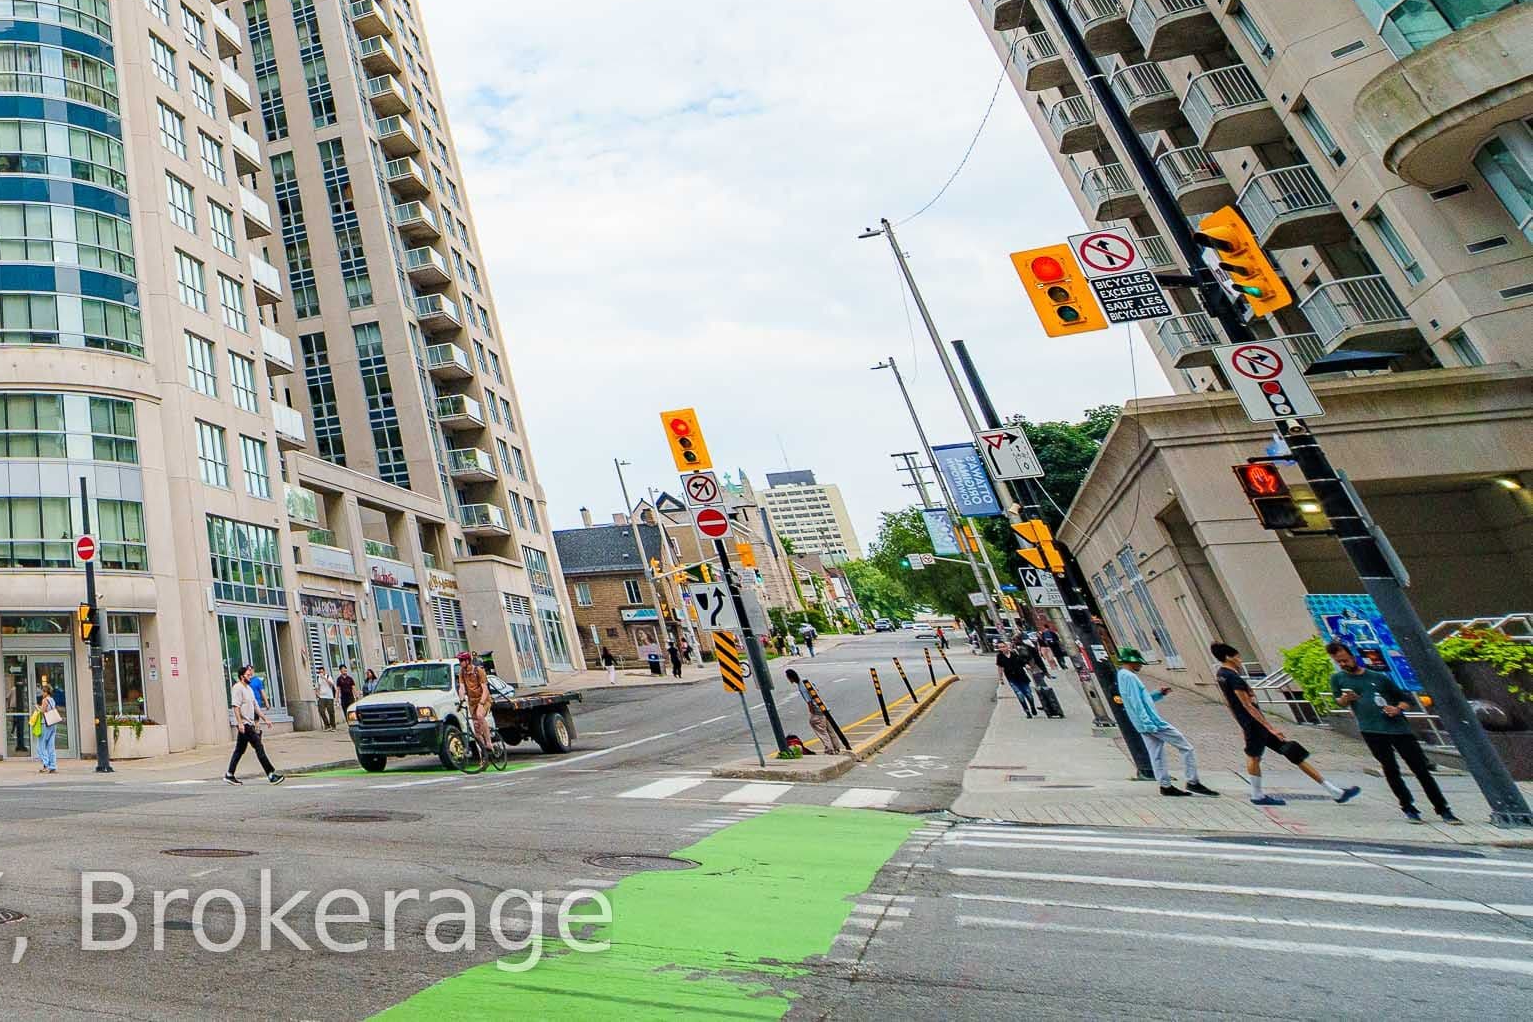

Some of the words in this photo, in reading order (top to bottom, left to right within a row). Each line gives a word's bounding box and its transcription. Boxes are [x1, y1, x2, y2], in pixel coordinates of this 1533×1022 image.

[1094, 273, 1150, 290] BICYCLES
[1099, 283, 1155, 298] EXCEPTED
[1105, 299, 1135, 312] SAUF
[1142, 296, 1164, 307] LES
[1108, 305, 1169, 321] BICYCLETTES
